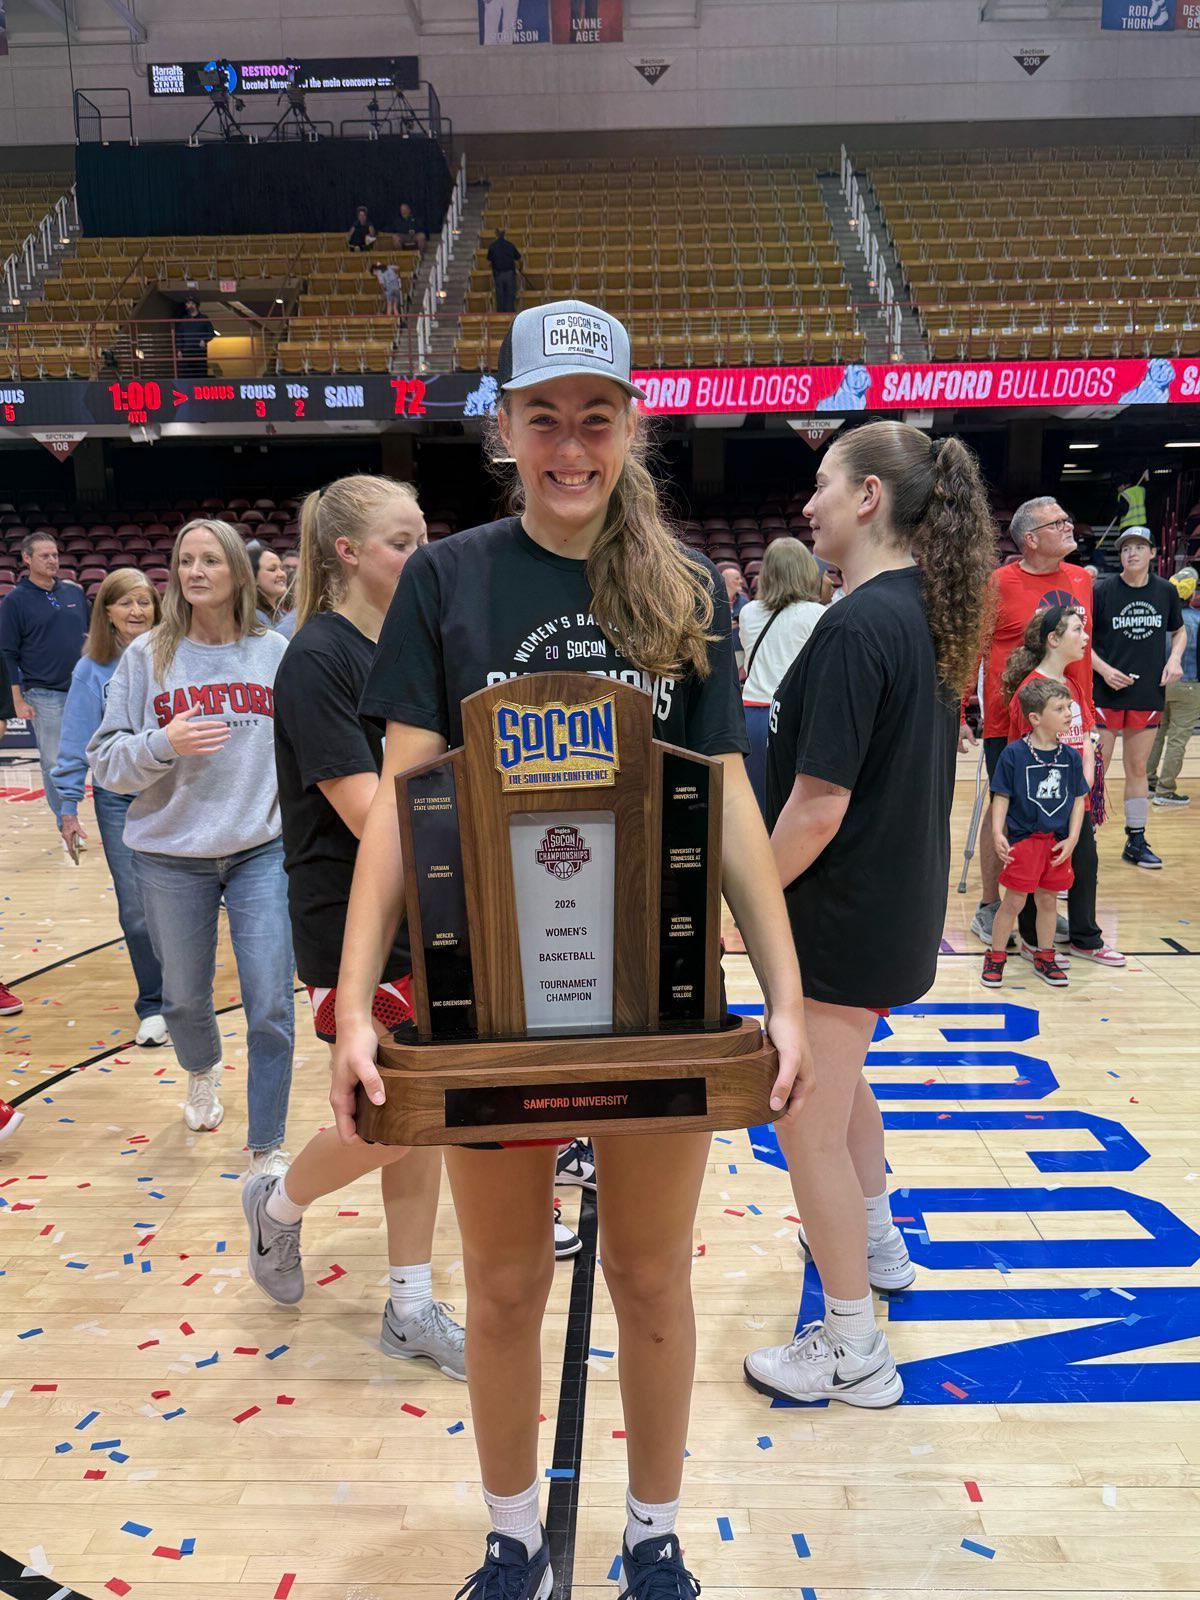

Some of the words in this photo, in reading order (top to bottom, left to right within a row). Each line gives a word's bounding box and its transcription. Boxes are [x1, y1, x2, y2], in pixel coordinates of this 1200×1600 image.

[1129, 6, 1148, 17] ROD
[572, 18, 602, 29] LYNNE
[1122, 17, 1154, 29] THORN
[575, 31, 600, 42] AGEE
[1023, 57, 1041, 66] 206
[241, 64, 300, 77] RESTROO
[644, 67, 661, 76] 207
[242, 79, 269, 90] Located
[310, 77, 321, 88] the
[550, 329, 609, 352] CHAMPS
[882, 370, 993, 401] SAMFORD
[997, 367, 1116, 398] BULLDOGS
[108, 381, 162, 411] 1:00
[240, 384, 276, 400] FOULS
[324, 385, 364, 408] SAM
[391, 379, 427, 414] 72
[632, 377, 691, 408] FORD
[696, 375, 812, 407] BULLDOGS
[5, 405, 16, 422] 5
[255, 401, 266, 417] 3
[295, 400, 305, 417] 2
[807, 430, 824, 439] 107
[52, 442, 69, 451] 108
[1112, 615, 1162, 630] CHAMPIONS
[513, 616, 571, 663] WOMEN'S
[545, 645, 559, 660] 20
[508, 774, 522, 785] THE
[523, 771, 561, 784] SOUTHERN
[563, 769, 609, 782] CONFERENCE
[538, 850, 590, 862] CHAMPIONSHIPS
[554, 899, 576, 909] 2026
[545, 926, 588, 937] WOMEN'S
[539, 951, 596, 962] BASKETBALL
[540, 978, 598, 990] TOURNAMENT
[546, 991, 592, 1003] CHAMPION
[523, 1096, 570, 1110] SAMFORD
[571, 1094, 629, 1108] UNIVERSITY
